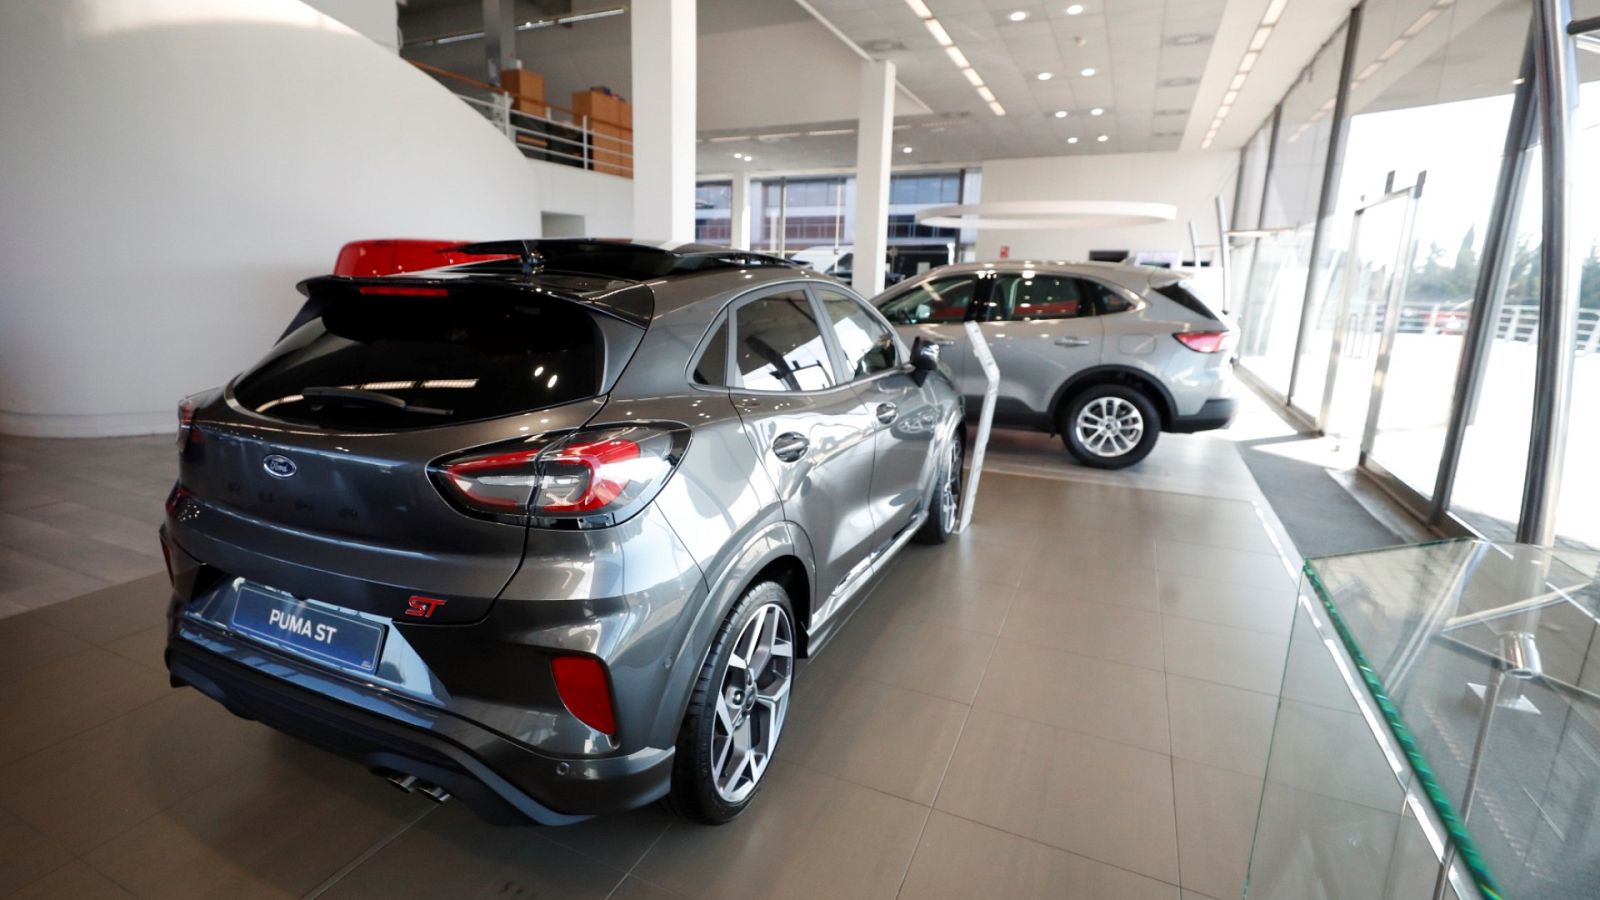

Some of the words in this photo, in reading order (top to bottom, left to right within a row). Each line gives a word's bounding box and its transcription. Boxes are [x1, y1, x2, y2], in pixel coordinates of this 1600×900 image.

[405, 595, 447, 618] ST
[268, 608, 313, 635] PUMA
[315, 624, 338, 645] ST
